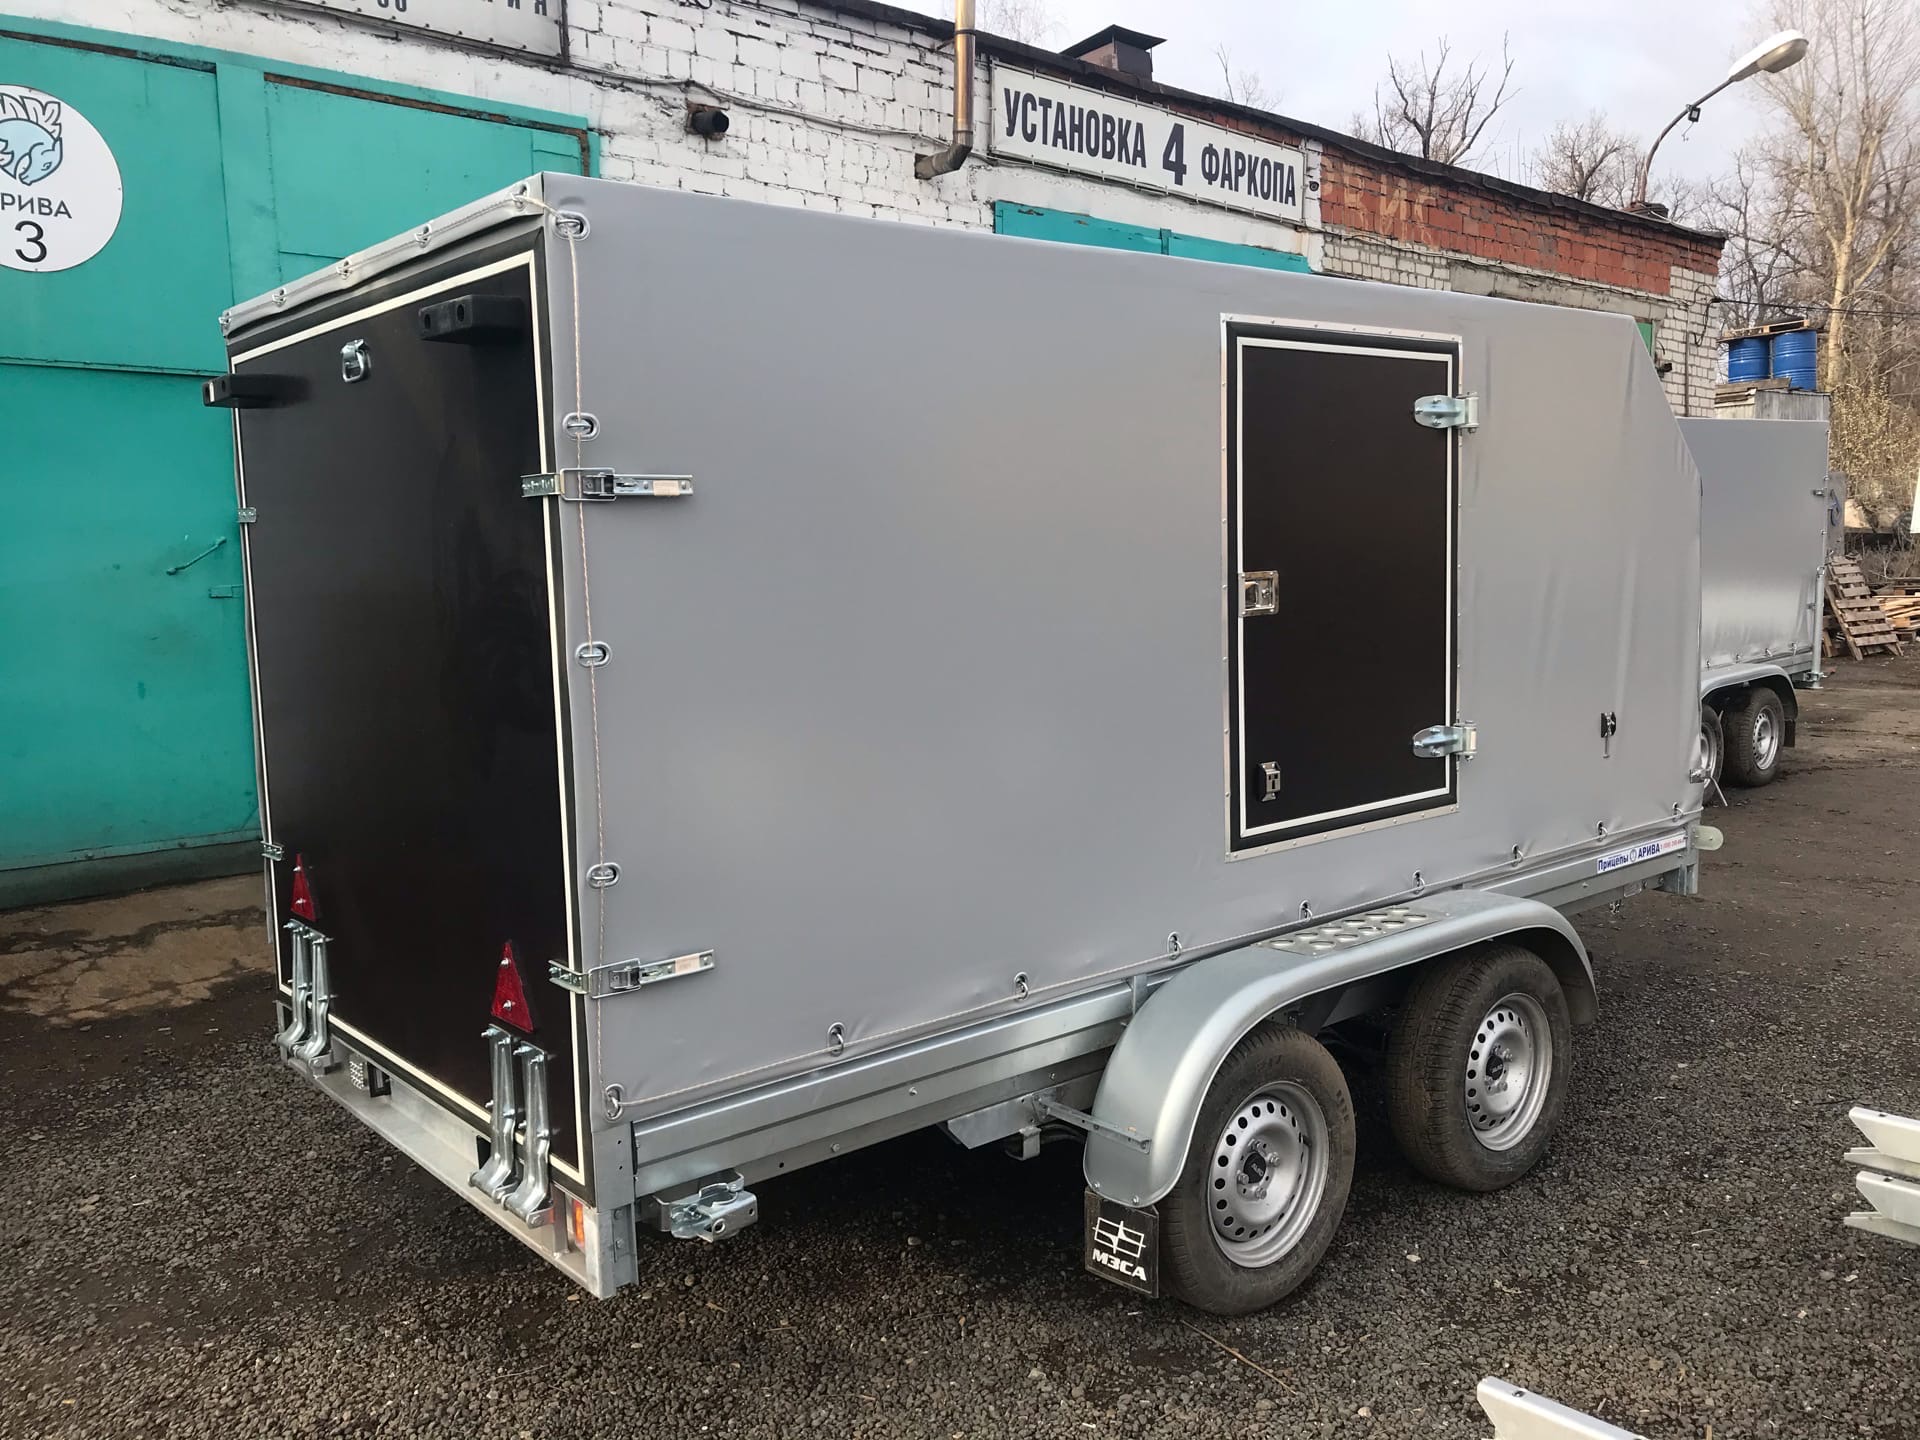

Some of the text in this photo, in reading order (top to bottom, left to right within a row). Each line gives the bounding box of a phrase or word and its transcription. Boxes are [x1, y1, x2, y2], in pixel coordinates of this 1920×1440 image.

[1004, 88, 1297, 207] УСТАНОВКА 4 ФАРКОПА
[15, 220, 47, 263] 3
[1598, 855, 1629, 871] Прицепы
[1638, 843, 1660, 858] АРИВА
